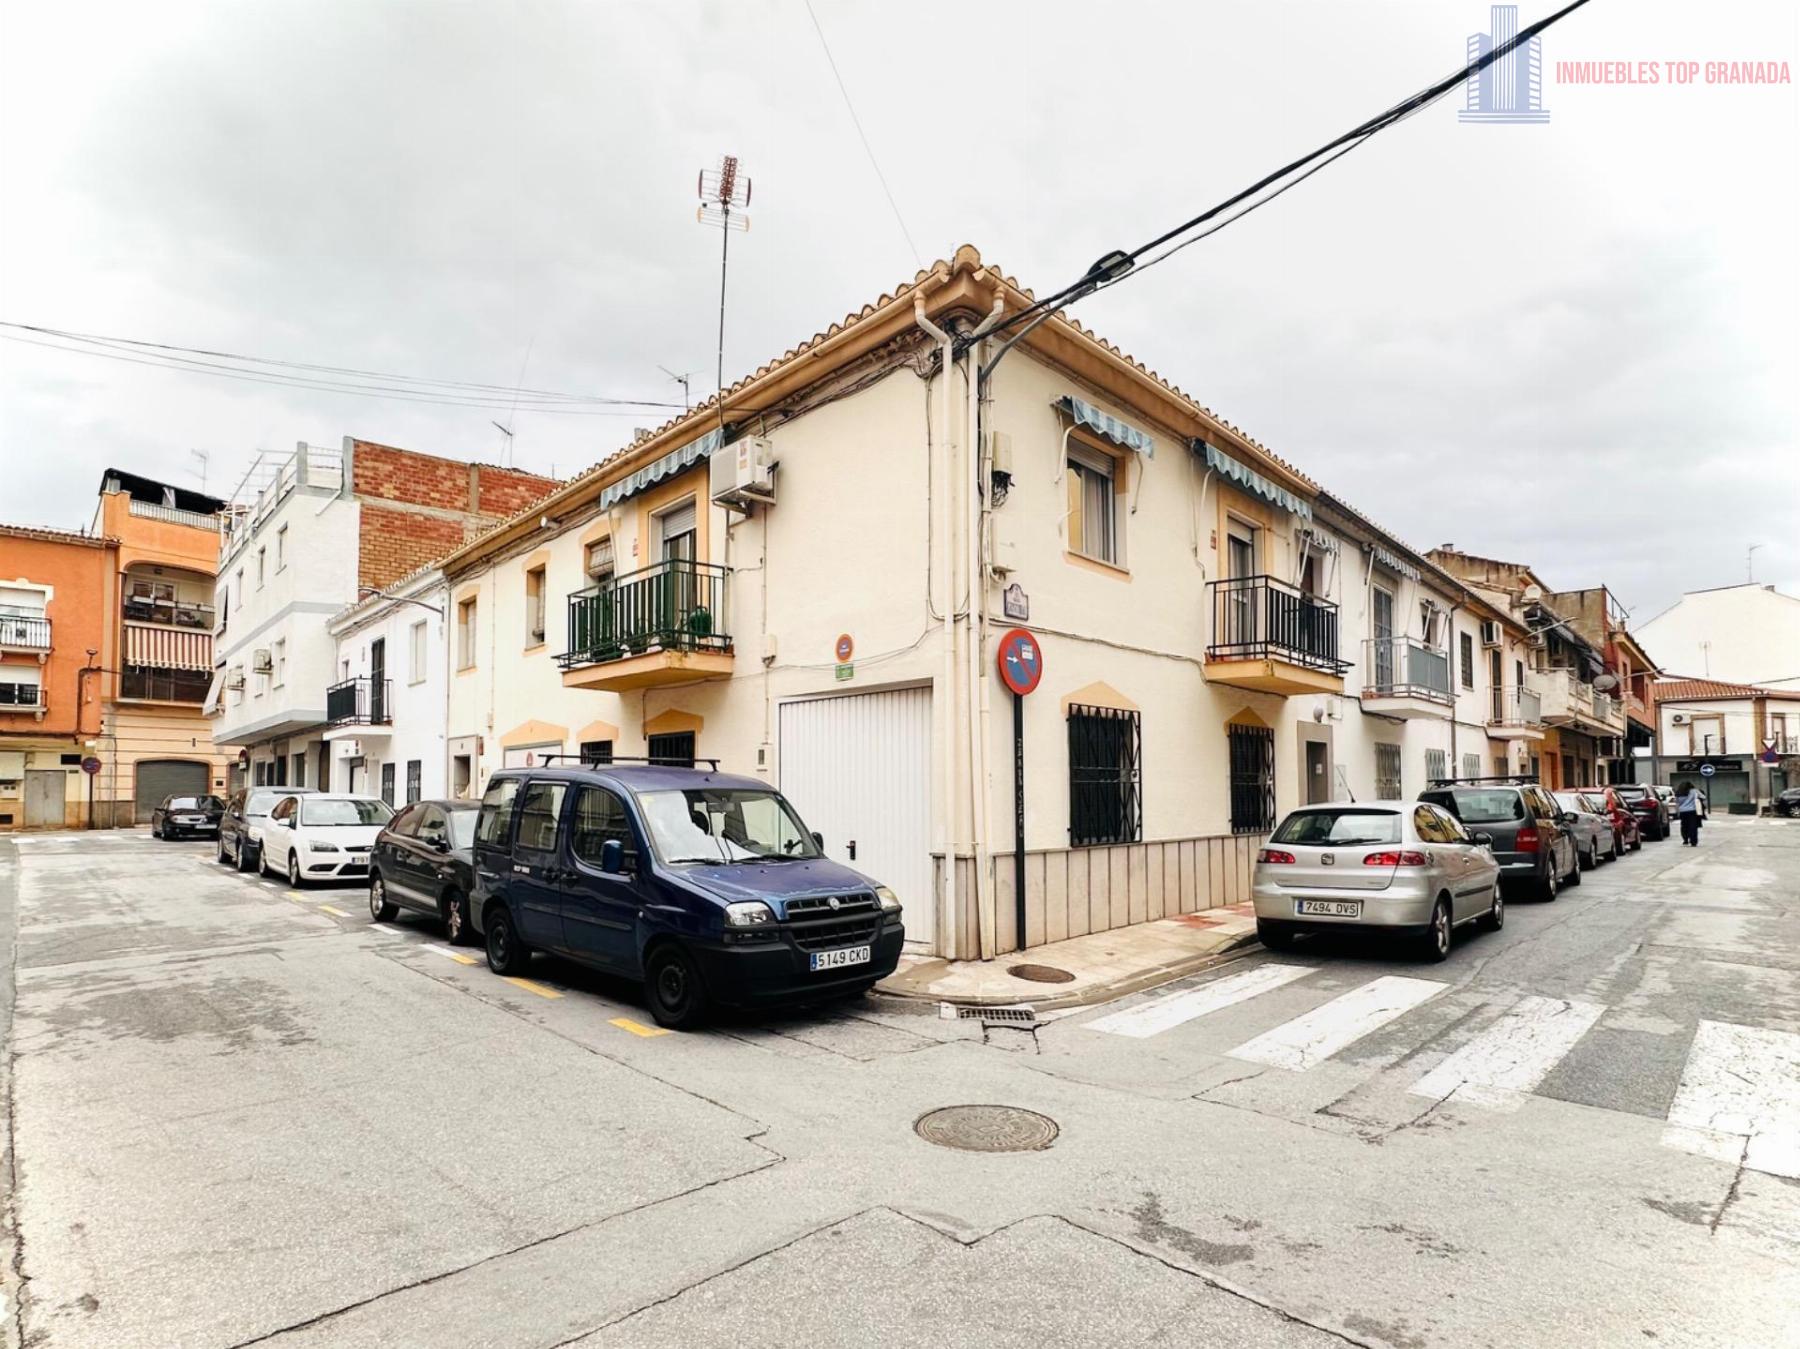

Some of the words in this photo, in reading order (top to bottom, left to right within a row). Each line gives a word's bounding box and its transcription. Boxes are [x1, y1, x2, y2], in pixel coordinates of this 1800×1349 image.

[1306, 901, 1331, 913] 7494
[1336, 903, 1356, 914] DVS
[818, 951, 846, 967] 5149
[849, 947, 869, 963] CKD
